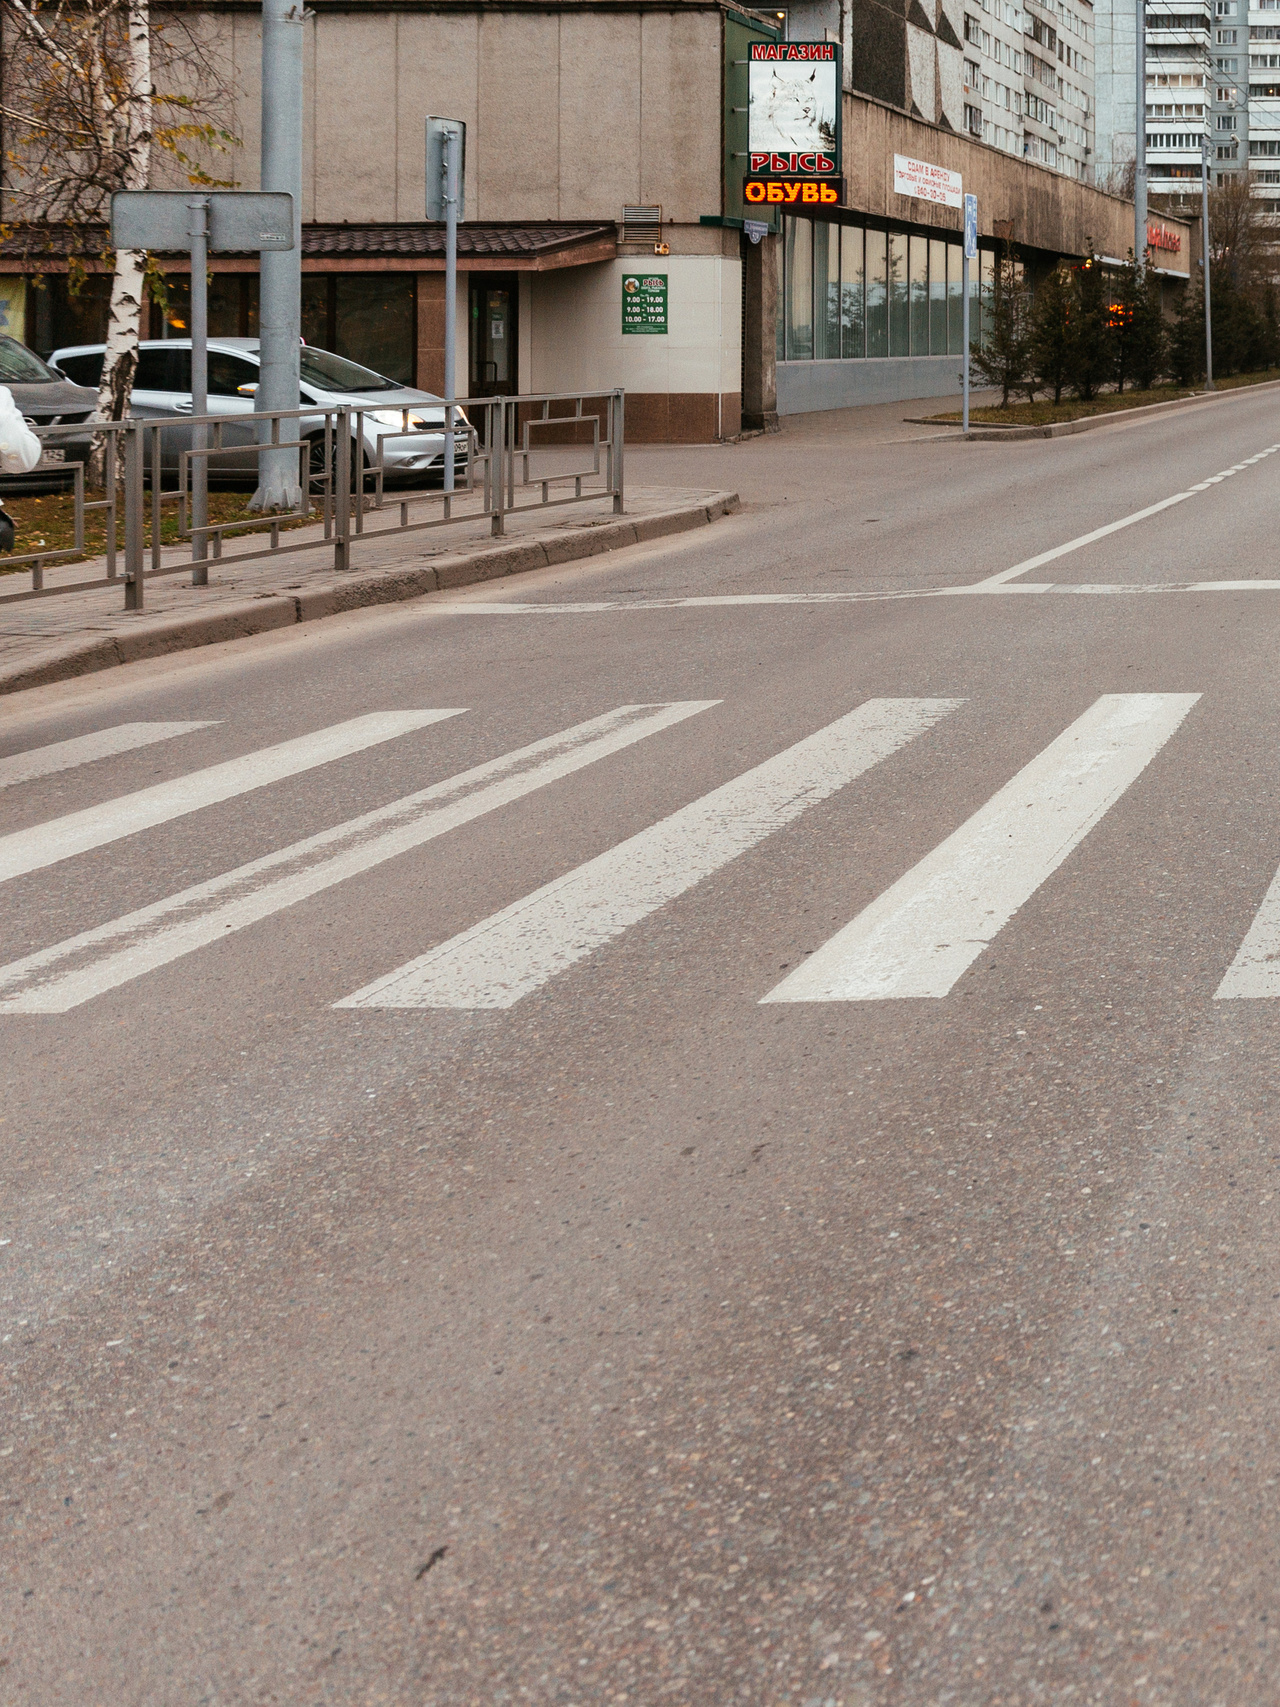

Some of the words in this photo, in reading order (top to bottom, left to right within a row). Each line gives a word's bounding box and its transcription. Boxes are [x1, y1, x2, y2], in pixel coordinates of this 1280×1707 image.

[752, 44, 834, 60] МАГАЗИН
[751, 153, 835, 172] РЫСЬ
[907, 161, 924, 175] СДАМ
[930, 168, 950, 182] АРЕНДУ
[745, 182, 838, 202] ОБУВЬ
